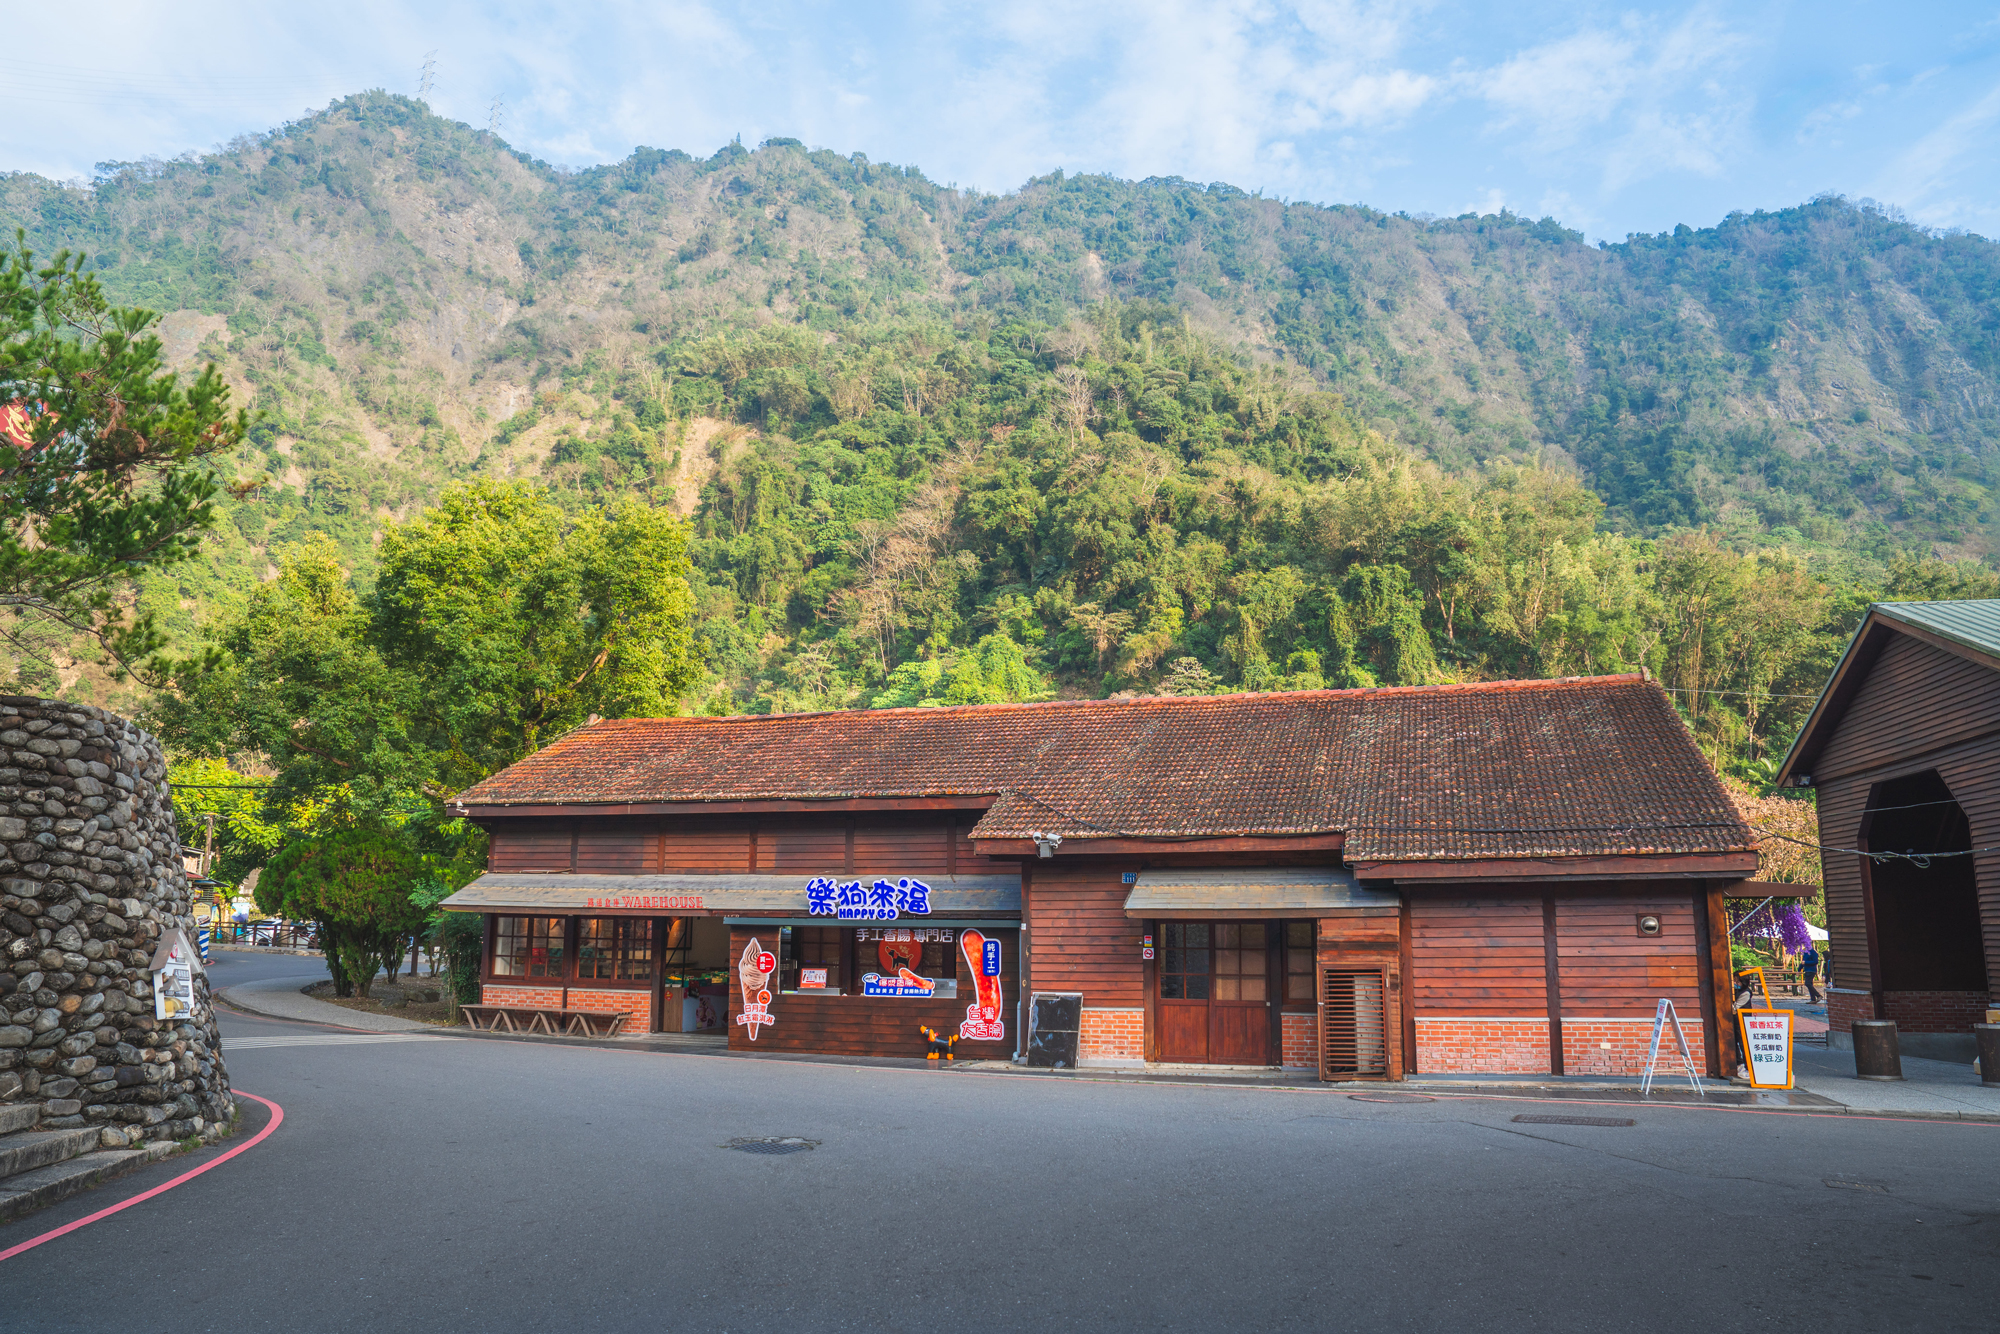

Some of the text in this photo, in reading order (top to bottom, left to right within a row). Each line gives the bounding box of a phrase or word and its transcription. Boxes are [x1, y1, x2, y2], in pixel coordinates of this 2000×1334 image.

[806, 878, 929, 914] 樂狗來福
[621, 896, 704, 908] WAREHOUSE
[838, 908, 896, 918] HAPPY GO
[744, 1004, 766, 1012] 日月潭
[968, 1006, 995, 1020] 台灣
[962, 1022, 1002, 1038] 大香腸
[1749, 1020, 1784, 1030] 蜜香紅茶
[1754, 1054, 1785, 1062] 綠豆沙
